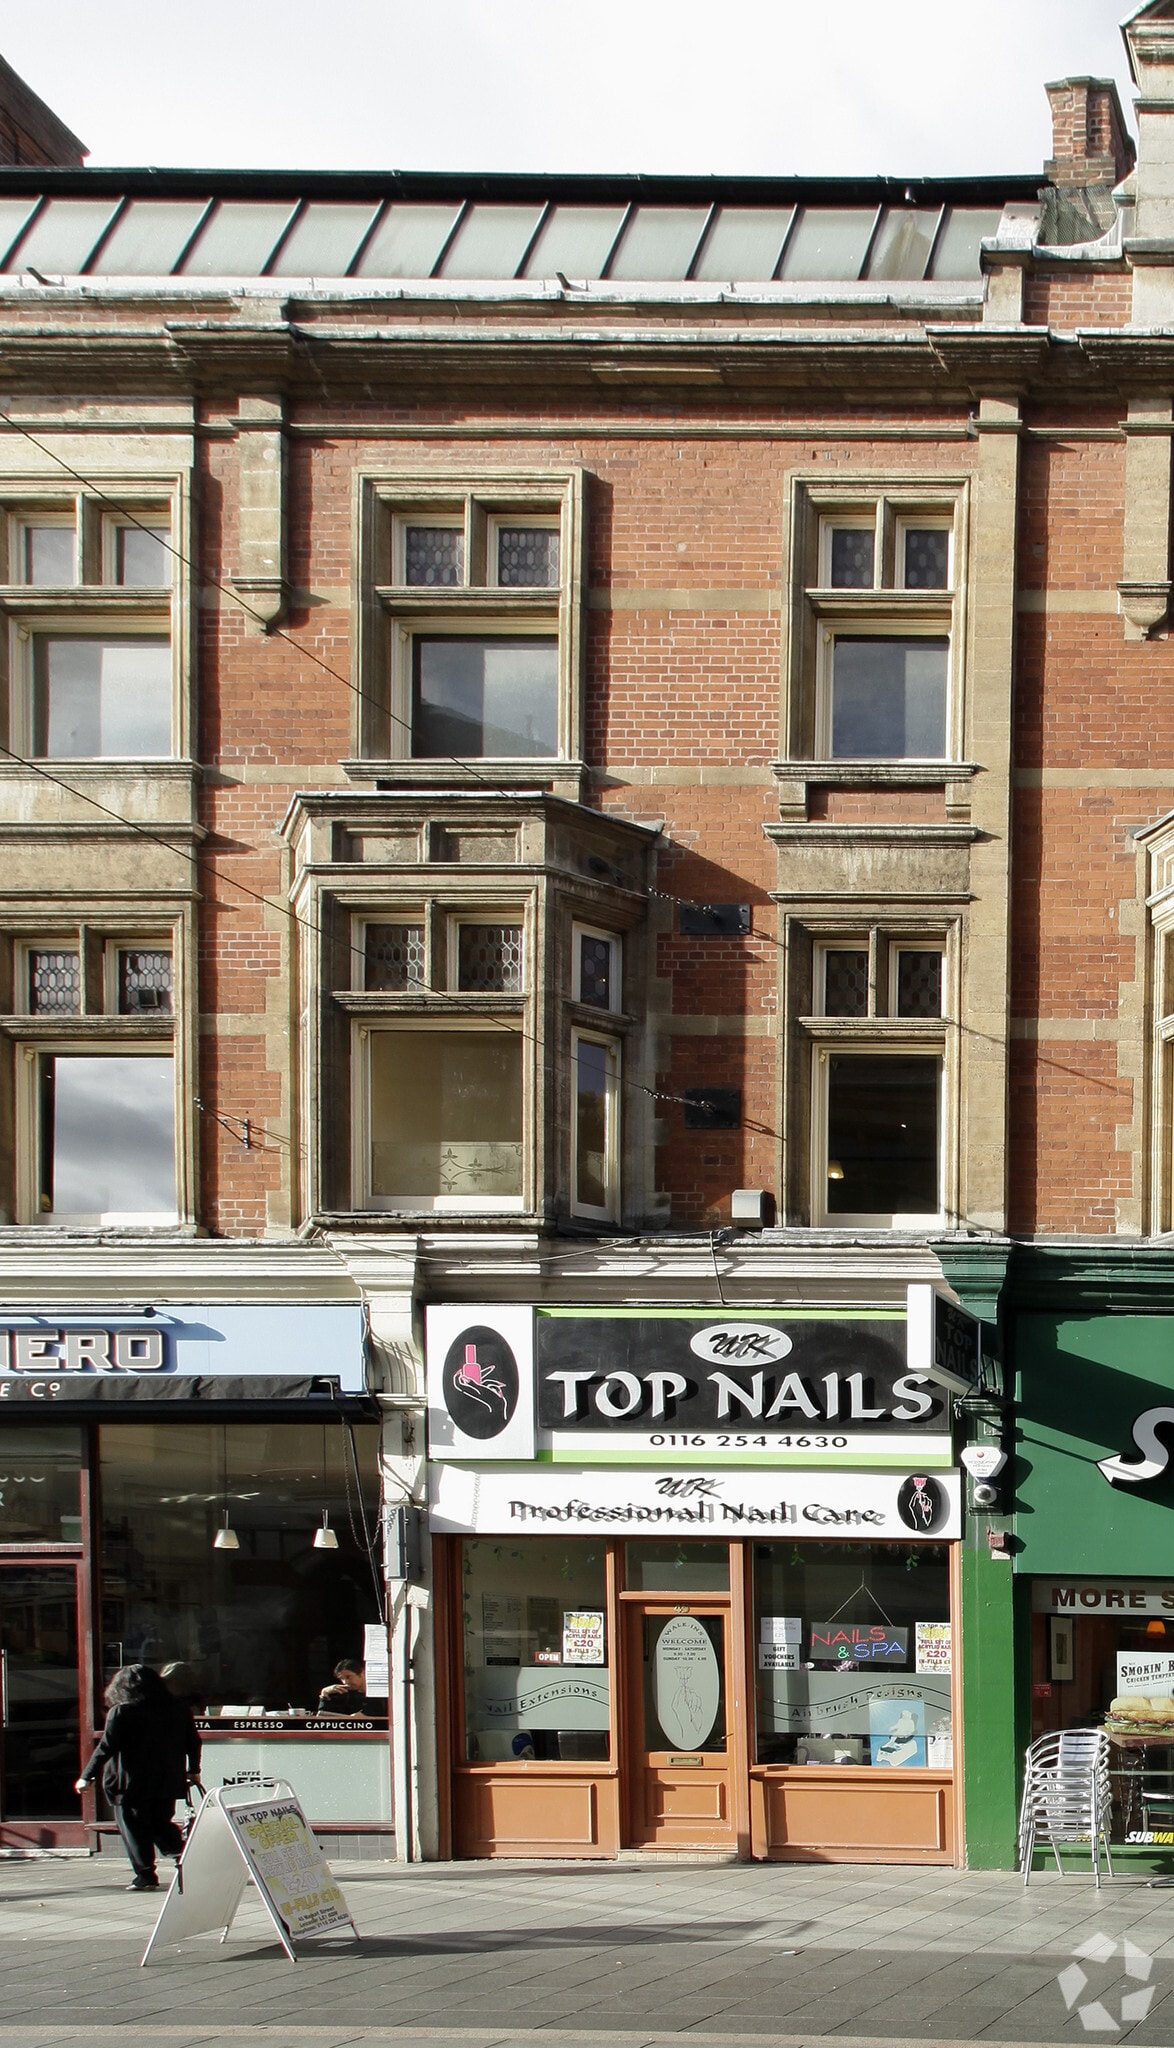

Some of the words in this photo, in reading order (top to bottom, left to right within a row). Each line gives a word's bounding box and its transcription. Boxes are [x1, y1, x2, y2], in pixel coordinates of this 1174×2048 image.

[0, 1328, 163, 1369] ERO
[545, 1371, 687, 1417] TOP
[707, 1371, 932, 1419] NAILS
[650, 1435, 706, 1446] 0116
[716, 1436, 768, 1447] 254
[778, 1436, 848, 1448] 4630
[508, 1499, 707, 1520] Professional
[719, 1501, 790, 1521] Nail
[802, 1504, 878, 1523] Care
[1051, 1588, 1147, 1609] MORE
[664, 1622, 704, 1636] WALK-INS
[811, 1626, 887, 1647] NAILS
[538, 1653, 559, 1662] OPEN
[837, 1646, 850, 1659] &
[854, 1641, 906, 1658] SPA
[1120, 1661, 1164, 1678] SMOKIN'
[520, 1685, 598, 1709] Extensions
[865, 1687, 923, 1700] Designs
[234, 1721, 284, 1729] ESPRESSO
[305, 1722, 373, 1730] CAPPUCCINO
[236, 1814, 251, 1825] UK
[251, 1810, 269, 1821] TOP
[270, 1804, 298, 1818] NAILS
[247, 1817, 300, 1839] SPECIAL
[260, 1830, 300, 1849] OFFER
[284, 1871, 319, 1896] £20
